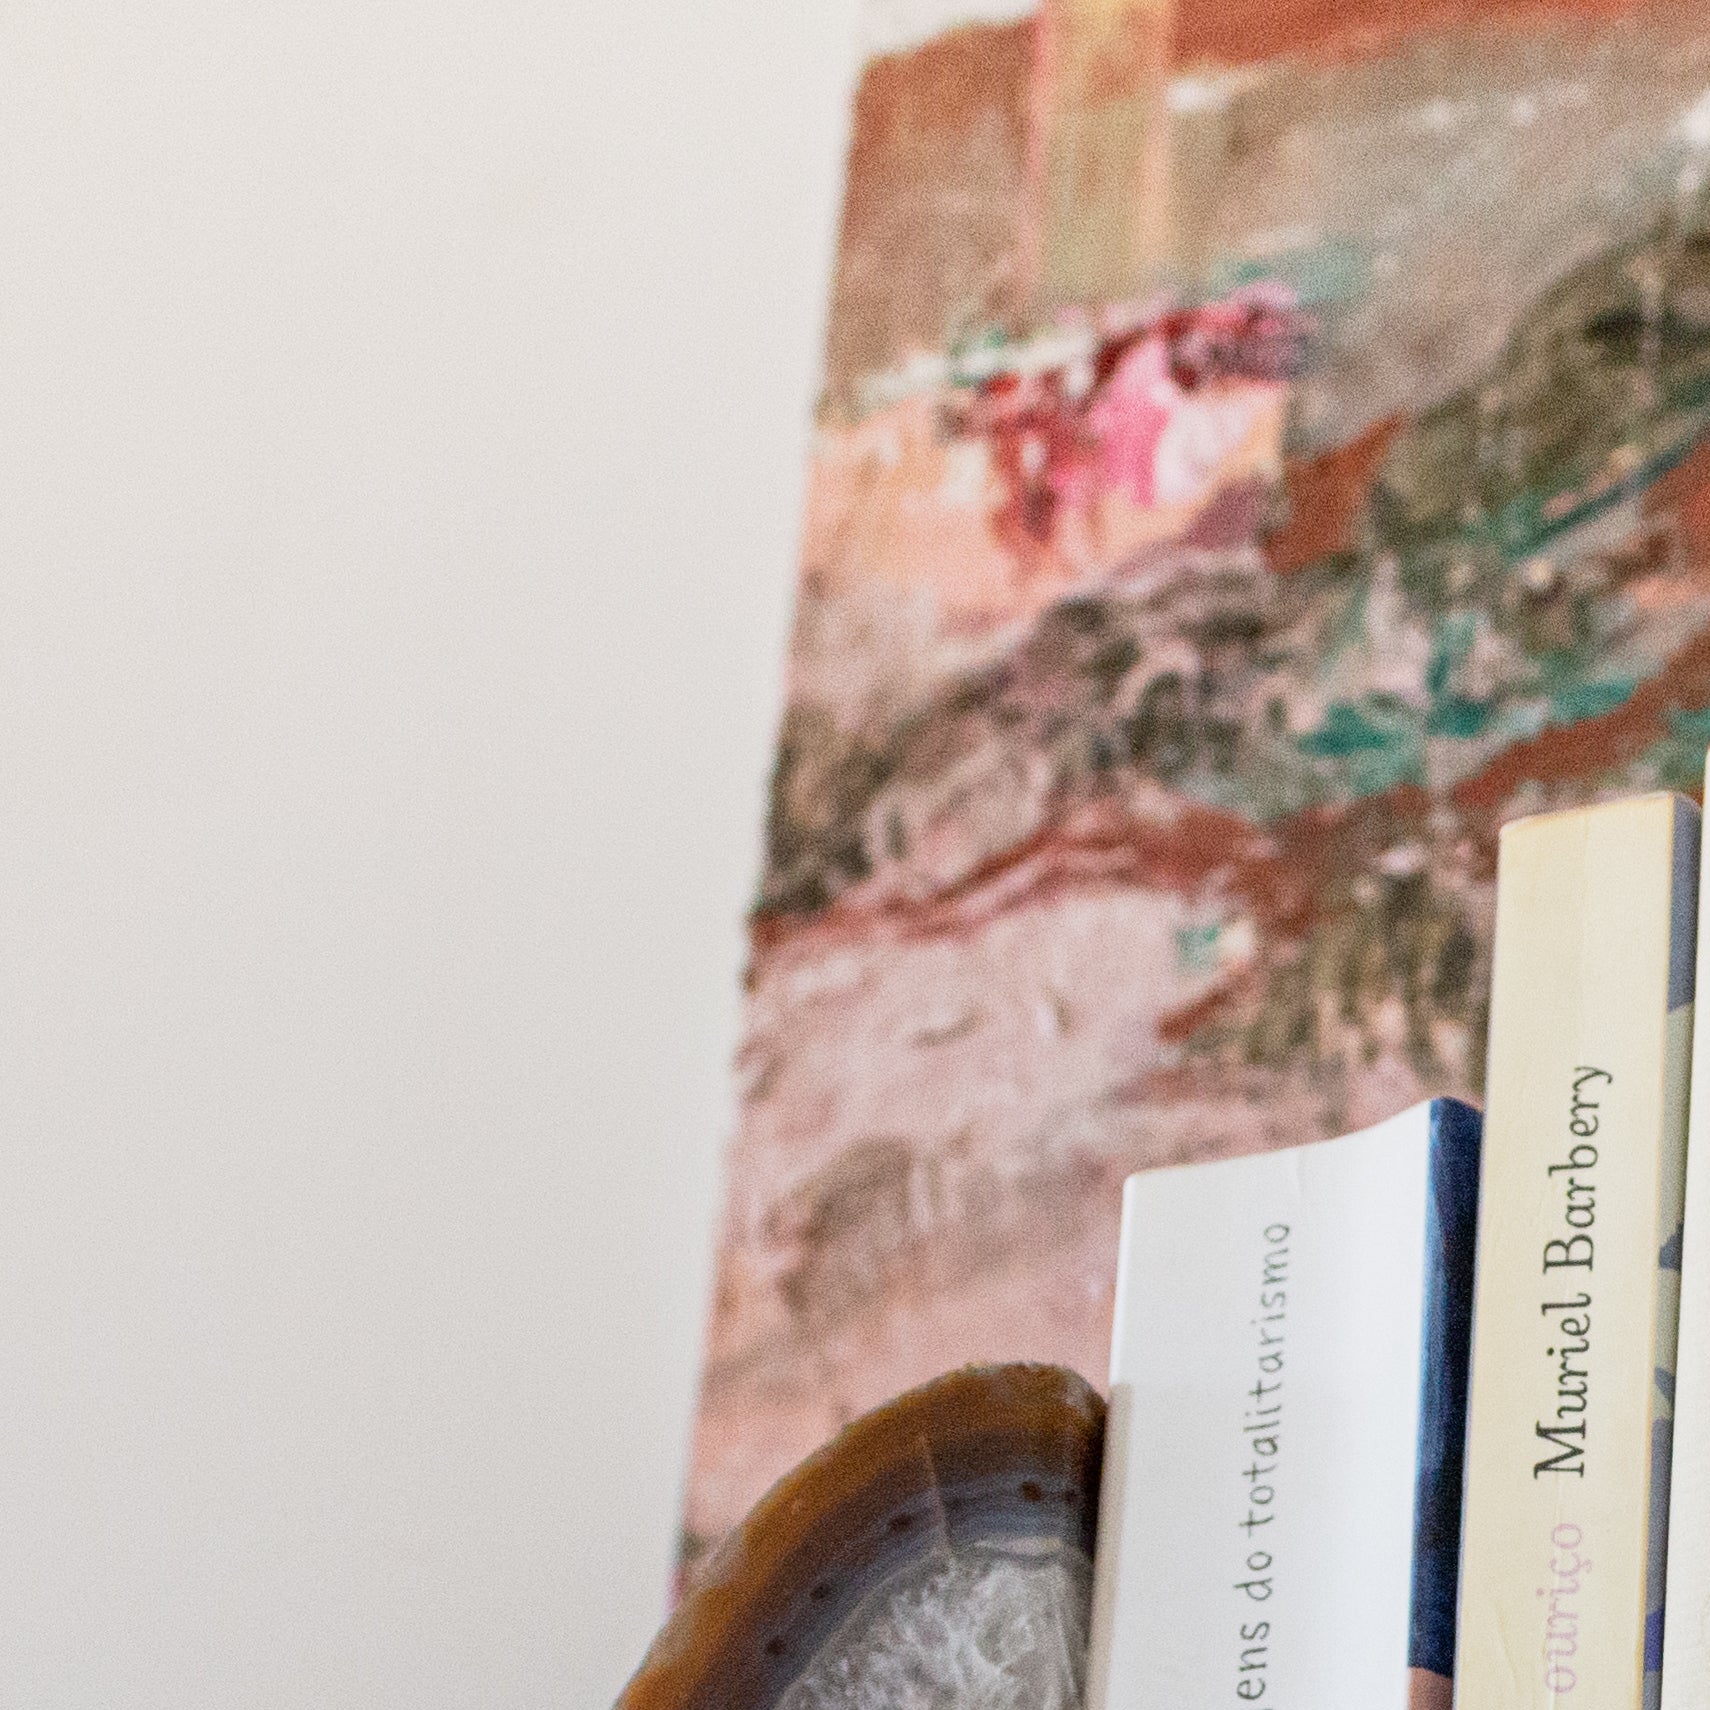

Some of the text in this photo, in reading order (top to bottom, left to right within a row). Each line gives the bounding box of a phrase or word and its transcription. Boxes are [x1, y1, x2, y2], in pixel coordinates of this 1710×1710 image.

[1543, 1066, 1613, 1274] Barbery
[1239, 1223, 1291, 1537] totalitarismo
[1533, 1292, 1592, 1479] Muriel
[1234, 1550, 1274, 1602] do
[1536, 1523, 1592, 1693] ouriço
